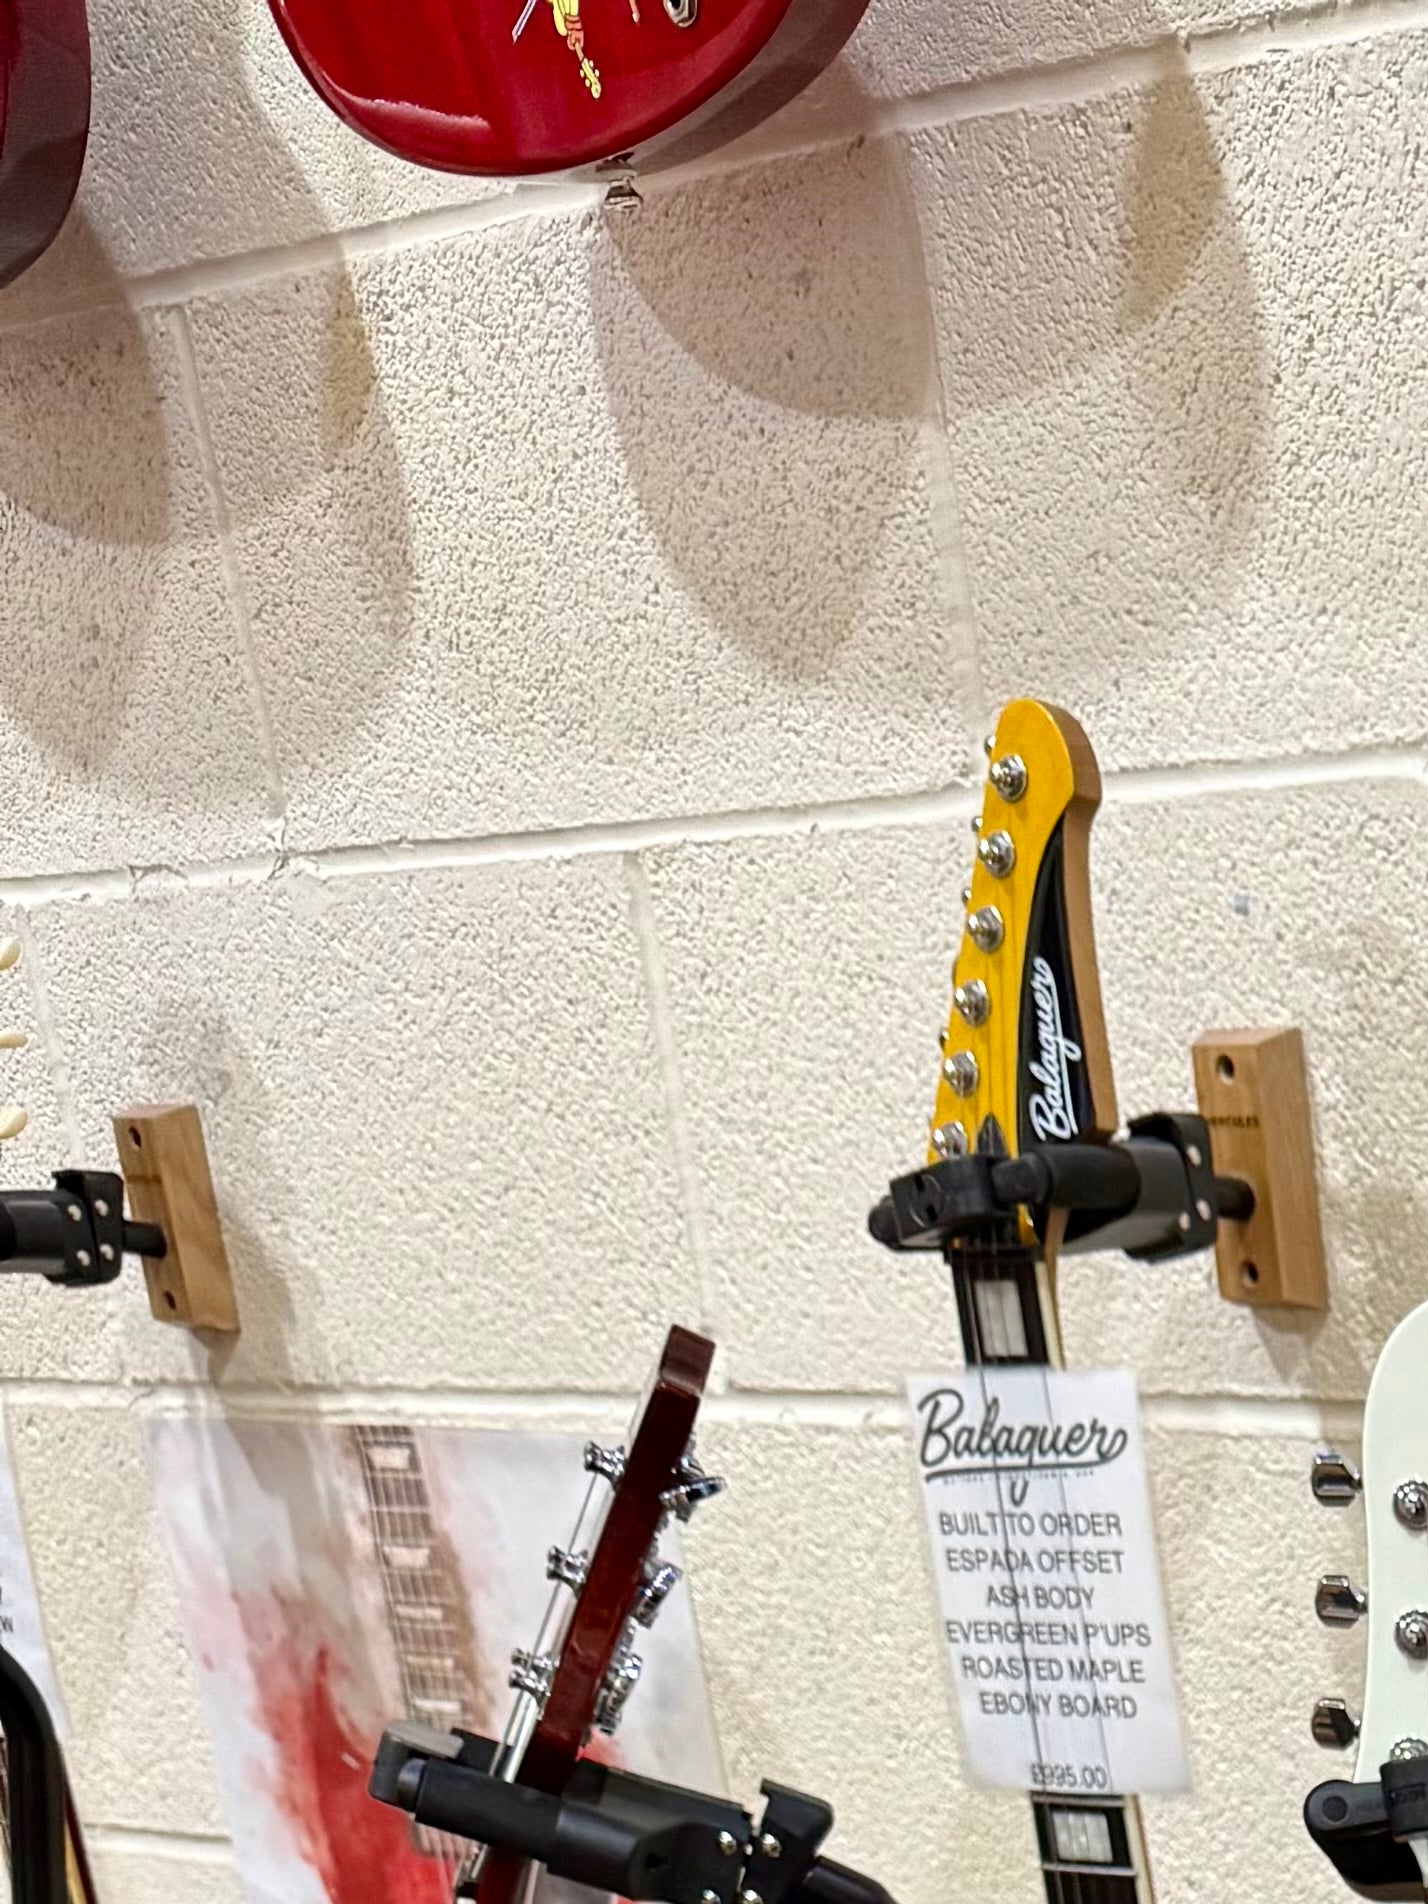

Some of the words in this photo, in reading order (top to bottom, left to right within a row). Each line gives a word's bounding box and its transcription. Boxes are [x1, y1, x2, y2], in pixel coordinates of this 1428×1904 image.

[1028, 956, 1082, 1141] Balaguer
[917, 1388, 1128, 1506] Balaguer
[940, 1512, 997, 1536] BUILT
[1009, 1514, 1034, 1536] TO
[1041, 1512, 1121, 1537] ORDER
[947, 1550, 1033, 1573] ESPADA
[1040, 1550, 1124, 1574] OFFSET
[987, 1585, 1029, 1609] ASH
[1035, 1586, 1094, 1609] BODY
[947, 1622, 1078, 1646] EVERGREEN
[1084, 1624, 1151, 1647] P'UPS
[962, 1657, 1063, 1681] ROASTED
[1068, 1660, 1145, 1683] MAPLE
[980, 1694, 1053, 1716] EBONY
[1061, 1695, 1137, 1719] BOARD
